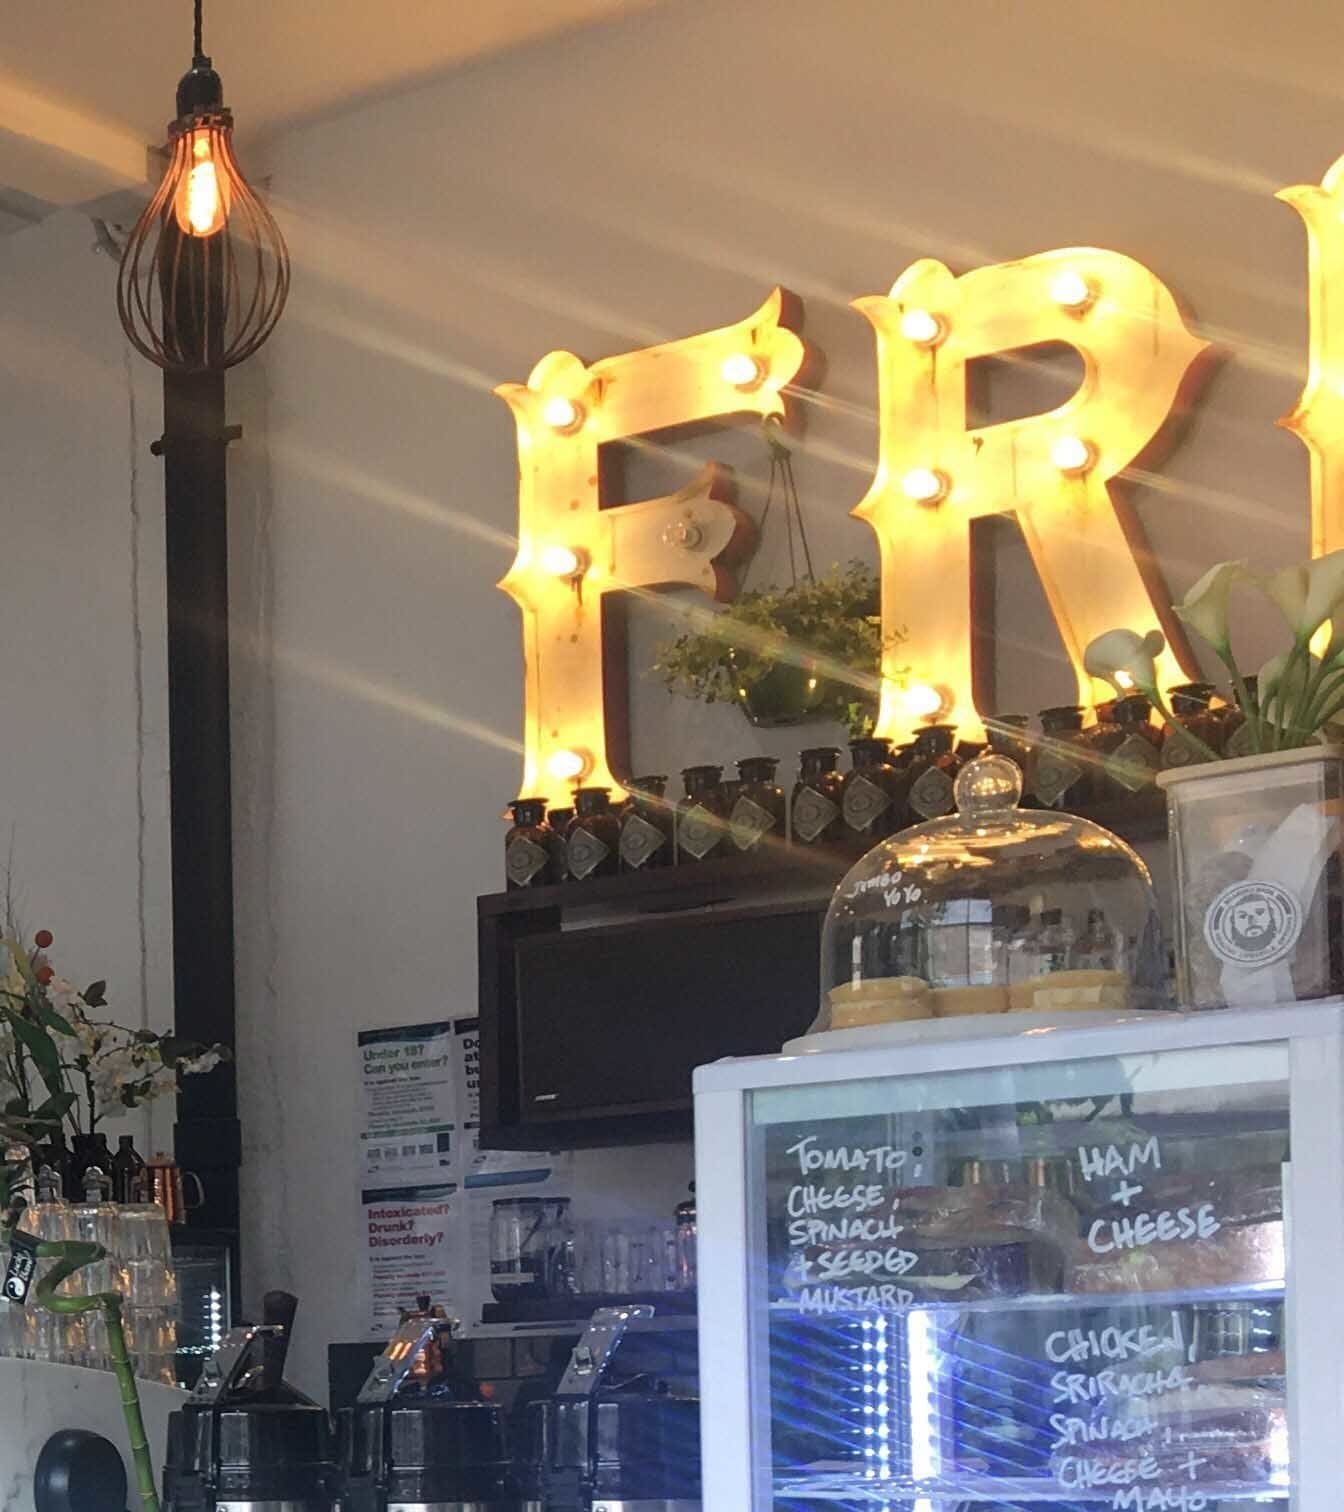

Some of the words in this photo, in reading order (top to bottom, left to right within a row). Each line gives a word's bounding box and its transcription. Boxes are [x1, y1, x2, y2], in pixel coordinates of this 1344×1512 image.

[363, 1048, 400, 1062] Under
[363, 1062, 386, 1075] Can
[388, 1061, 409, 1075] you
[1078, 1135, 1161, 1181] HAM
[368, 1203, 450, 1219] Intoxicated?
[368, 1220, 415, 1234] Drunk?
[1088, 1203, 1221, 1253] CHEESE
[368, 1232, 444, 1248] Disorderly?
[817, 1246, 919, 1280] SEEDED
[799, 1283, 914, 1317] MUSTARD
[1057, 1455, 1163, 1489] CHEESE
